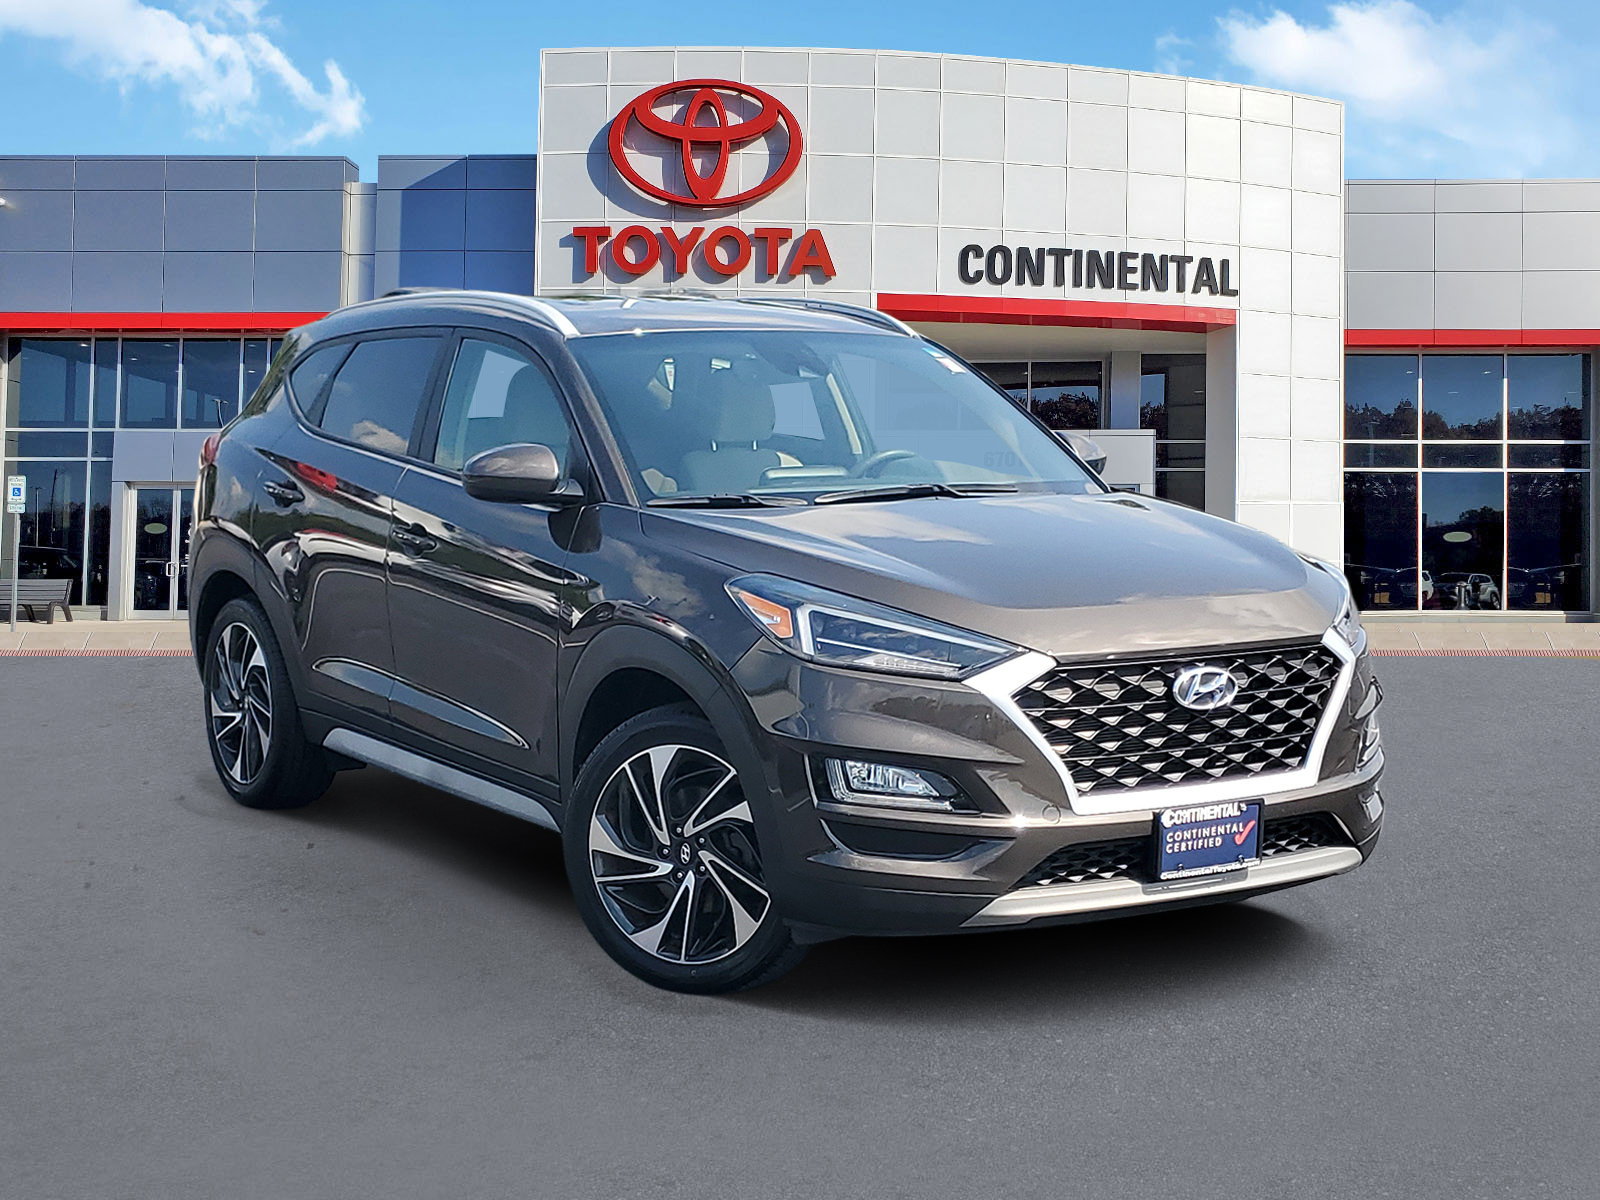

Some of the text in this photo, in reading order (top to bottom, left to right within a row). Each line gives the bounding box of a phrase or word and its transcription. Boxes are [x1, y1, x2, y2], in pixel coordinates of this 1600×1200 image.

[573, 225, 836, 277] TOYOTA
[958, 244, 1239, 296] CONTINENTAL
[1166, 822, 1244, 843] CONTINENTAL
[1166, 837, 1223, 854] CERTIFIED
